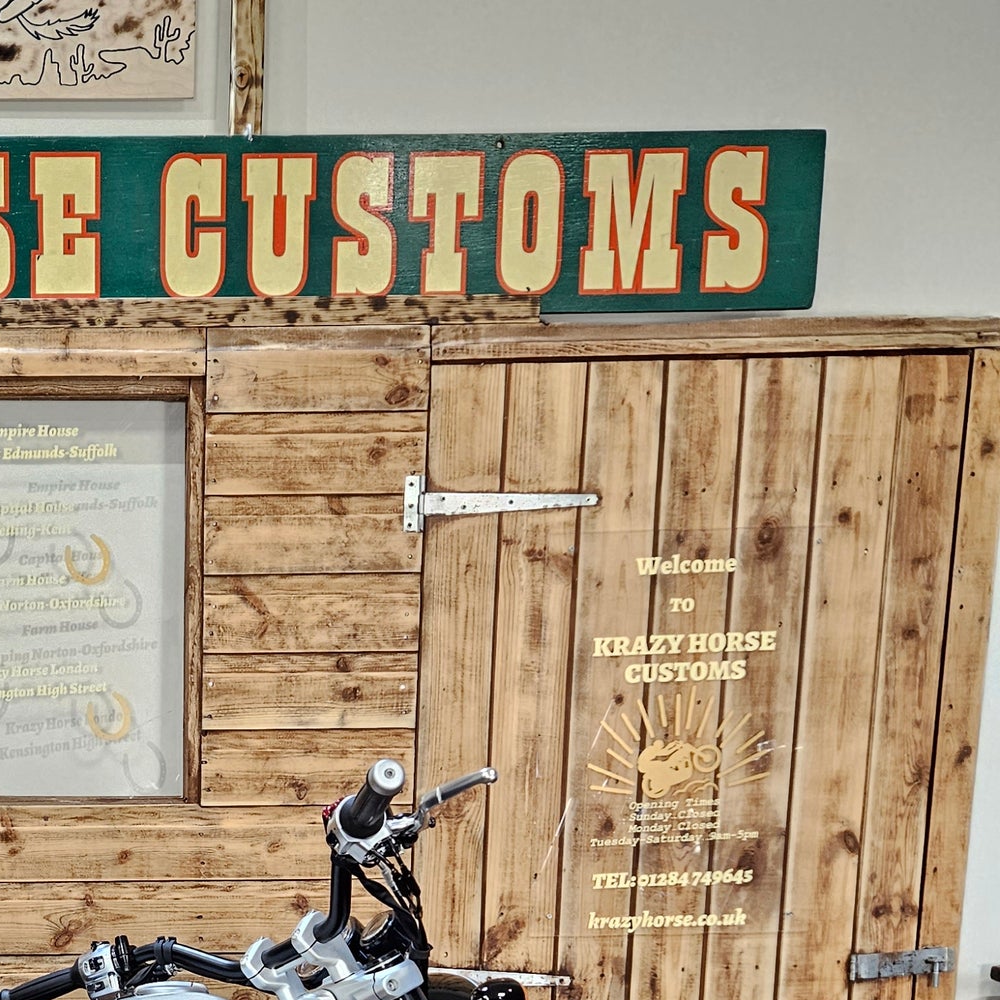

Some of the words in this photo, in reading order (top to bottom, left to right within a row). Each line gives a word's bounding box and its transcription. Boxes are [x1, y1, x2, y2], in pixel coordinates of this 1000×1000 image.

[159, 145, 769, 297] CUSTOMS
[37, 424, 79, 438] House
[3, 443, 118, 461] Edmunds-Suffolk
[636, 554, 737, 576] Welcome
[0, 596, 127, 612] Norton-Oxfordshire
[669, 597, 695, 612] TO
[592, 634, 685, 657] KRAZY
[687, 630, 777, 653] HORSE
[10, 663, 49, 677] Horse
[50, 663, 98, 675] London
[624, 660, 747, 684] CUSTOMS
[36, 684, 68, 698] High
[69, 683, 107, 695] Street
[629, 800, 679, 810] Opening
[686, 798, 720, 806] Times
[588, 908, 747, 933] krazyhorse.co.uk
